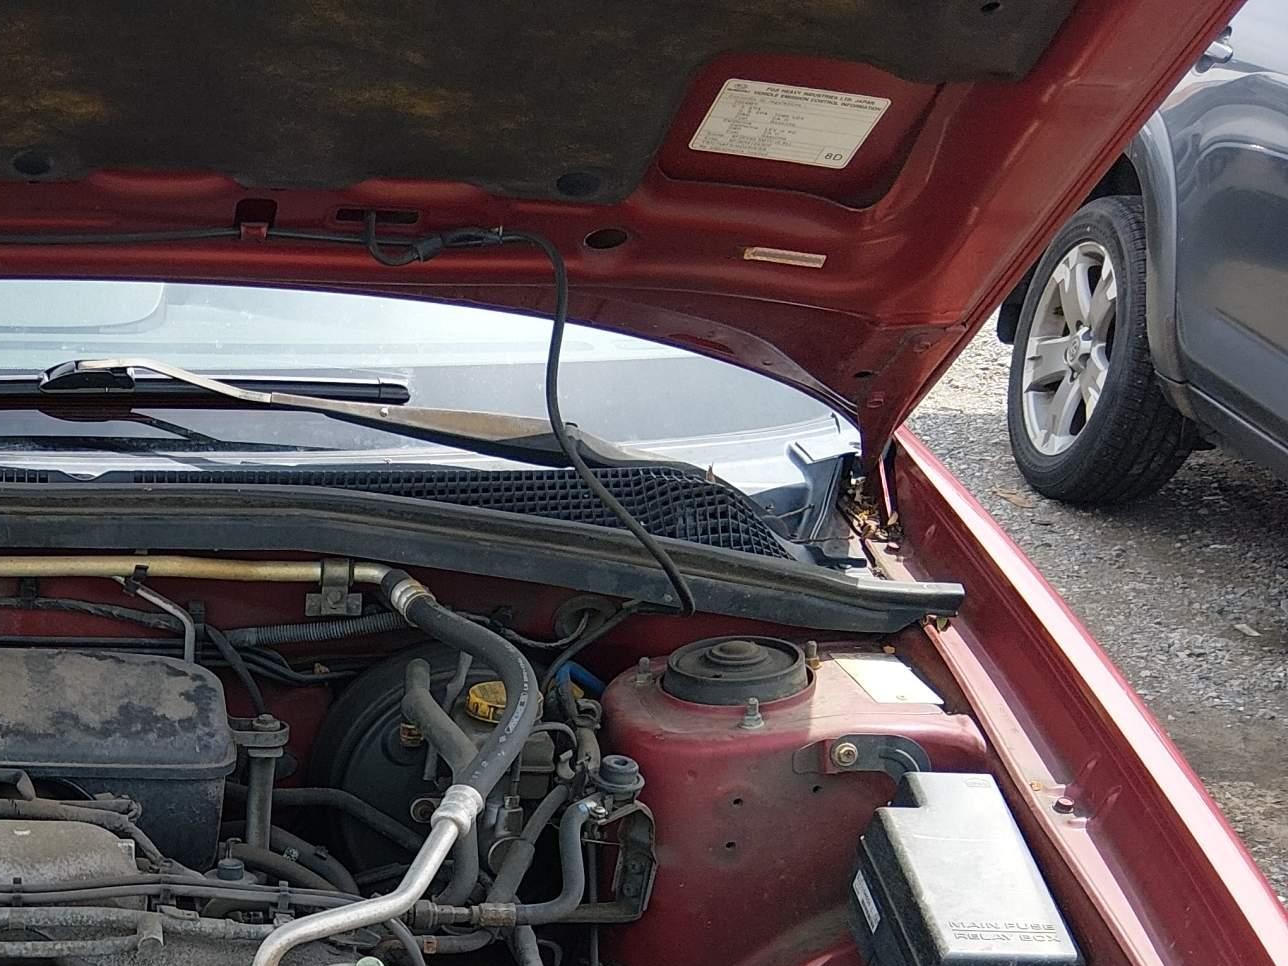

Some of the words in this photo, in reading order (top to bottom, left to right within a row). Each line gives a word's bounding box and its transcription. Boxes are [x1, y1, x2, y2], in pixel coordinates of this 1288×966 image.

[948, 921, 1001, 929] MAIN
[1004, 922, 1057, 931] FUSE
[953, 932, 1014, 941] RELAY
[1018, 934, 1062, 943] BOX
